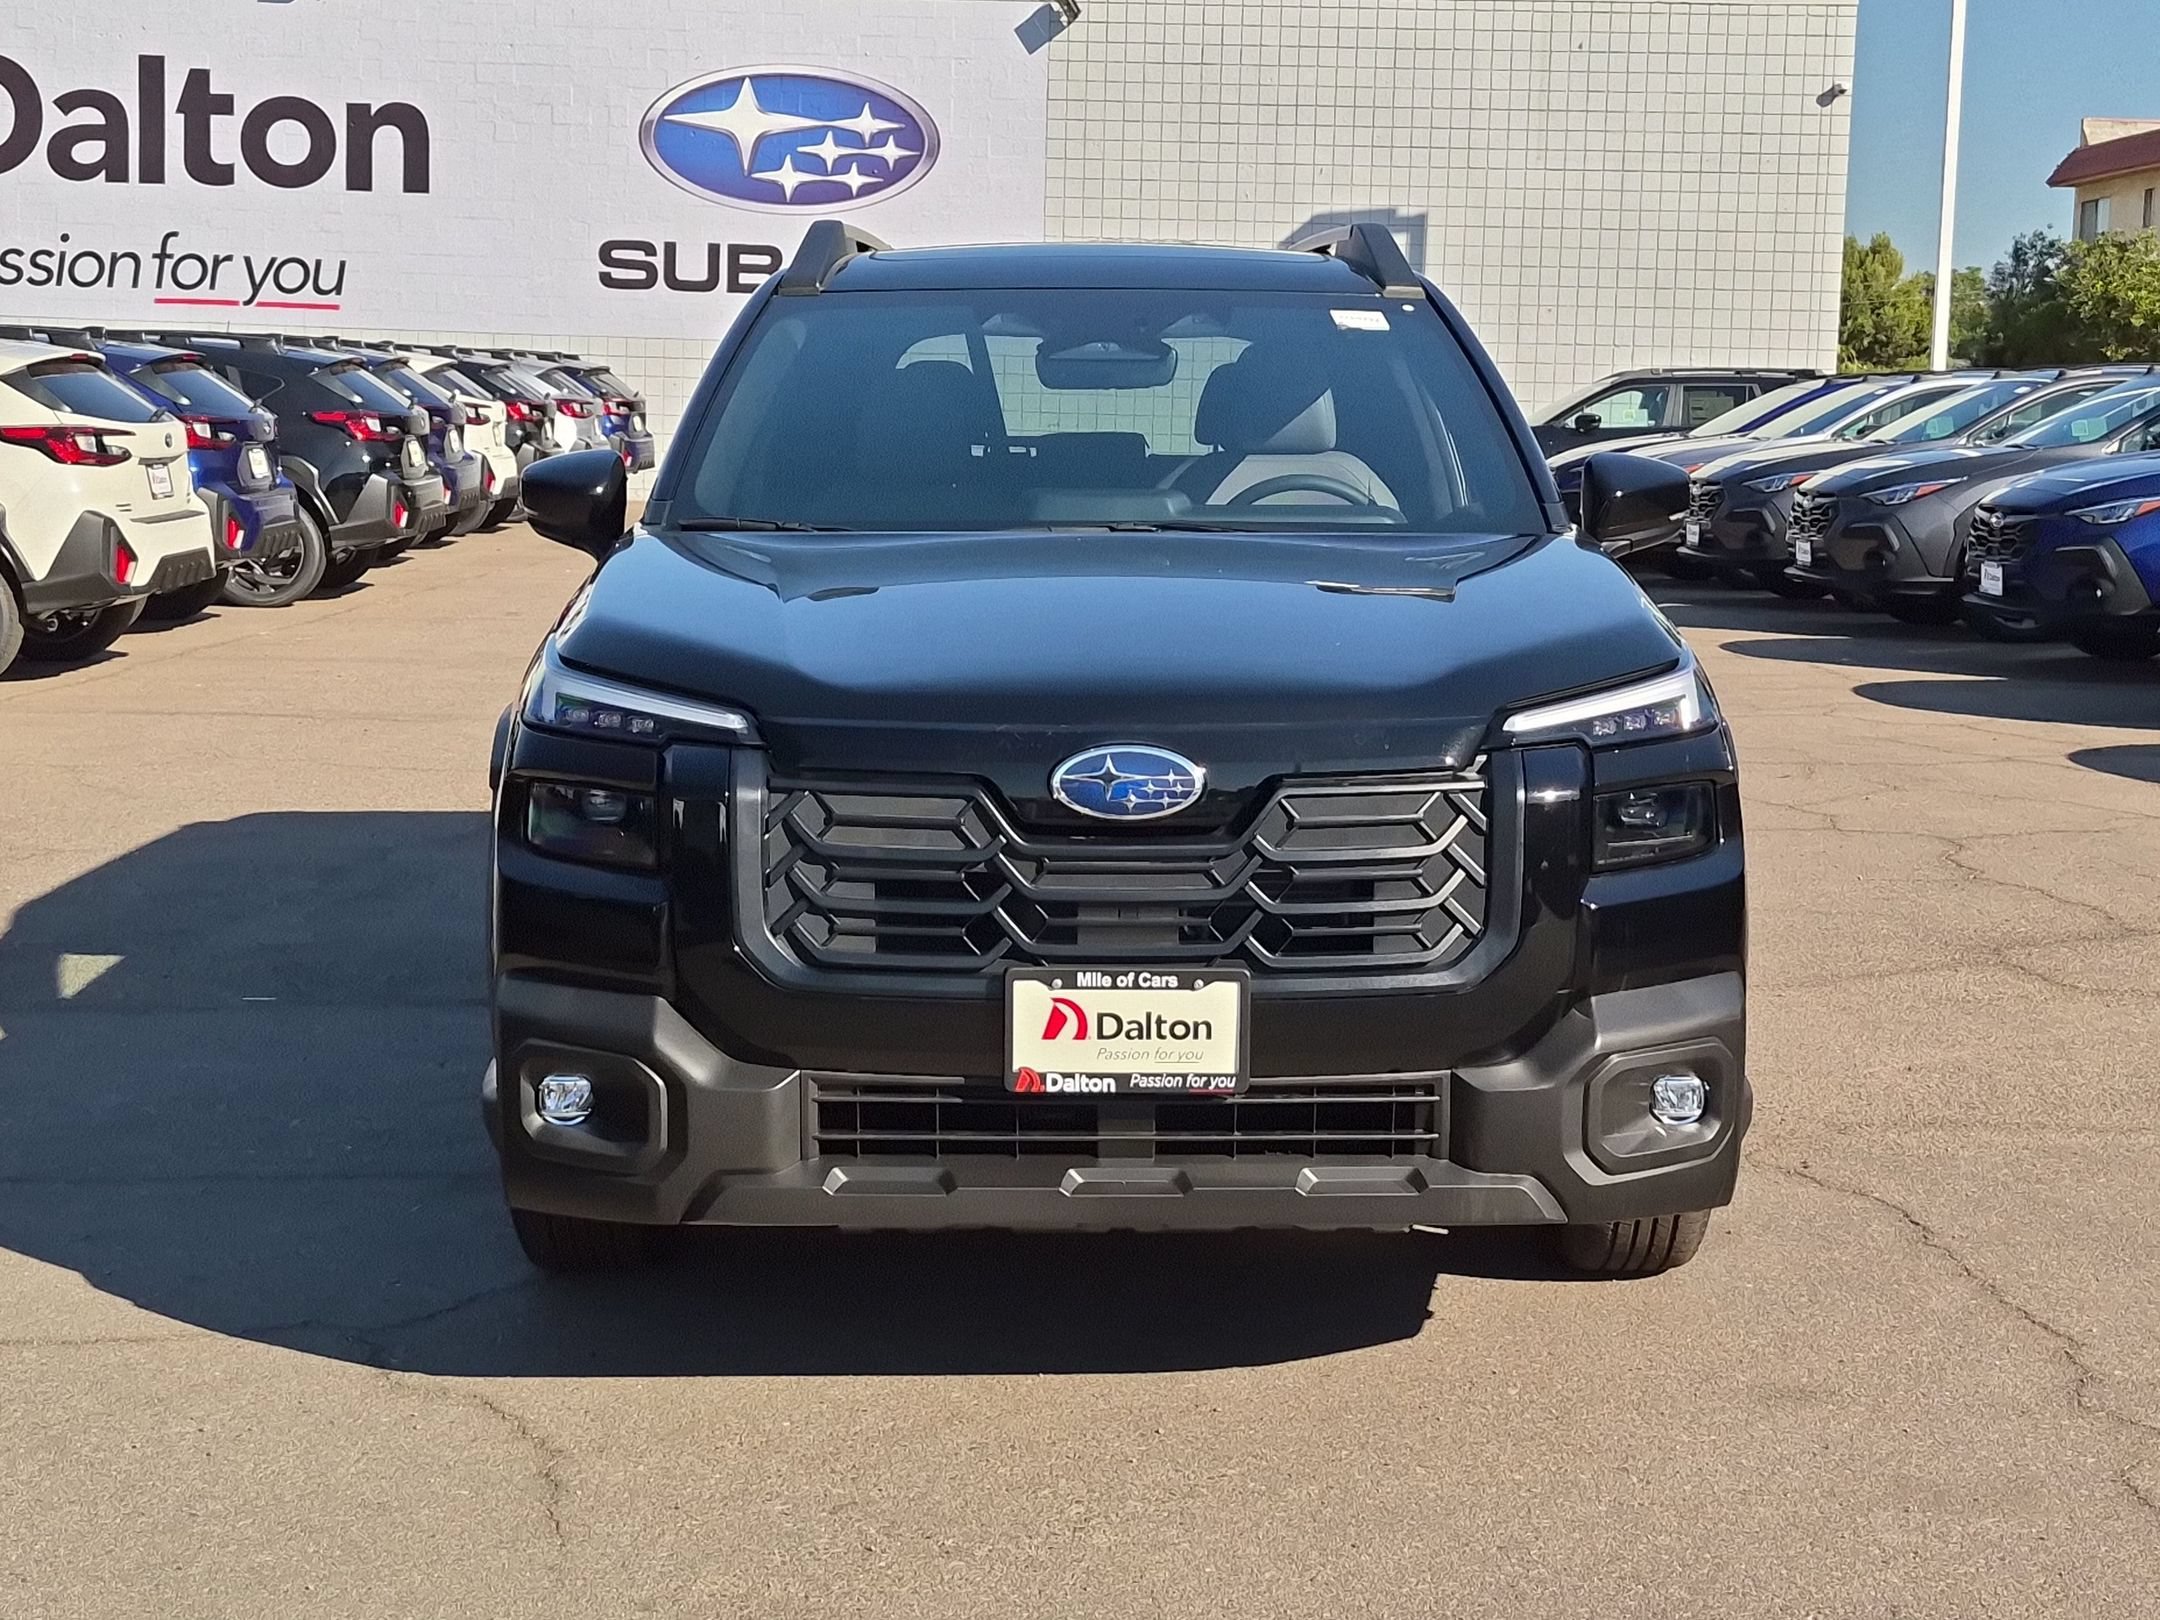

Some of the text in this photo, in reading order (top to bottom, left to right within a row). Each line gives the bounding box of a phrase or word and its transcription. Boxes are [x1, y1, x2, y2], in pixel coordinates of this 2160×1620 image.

[0, 231, 347, 306] ssion for you
[598, 239, 783, 293] SUB
[1076, 971, 1179, 988] Mile of Cars
[1096, 1011, 1212, 1041] Dalton
[1096, 1046, 1204, 1063] Passion for you
[1045, 1073, 1116, 1093] Dalton
[1129, 1073, 1237, 1090] Passion for you
